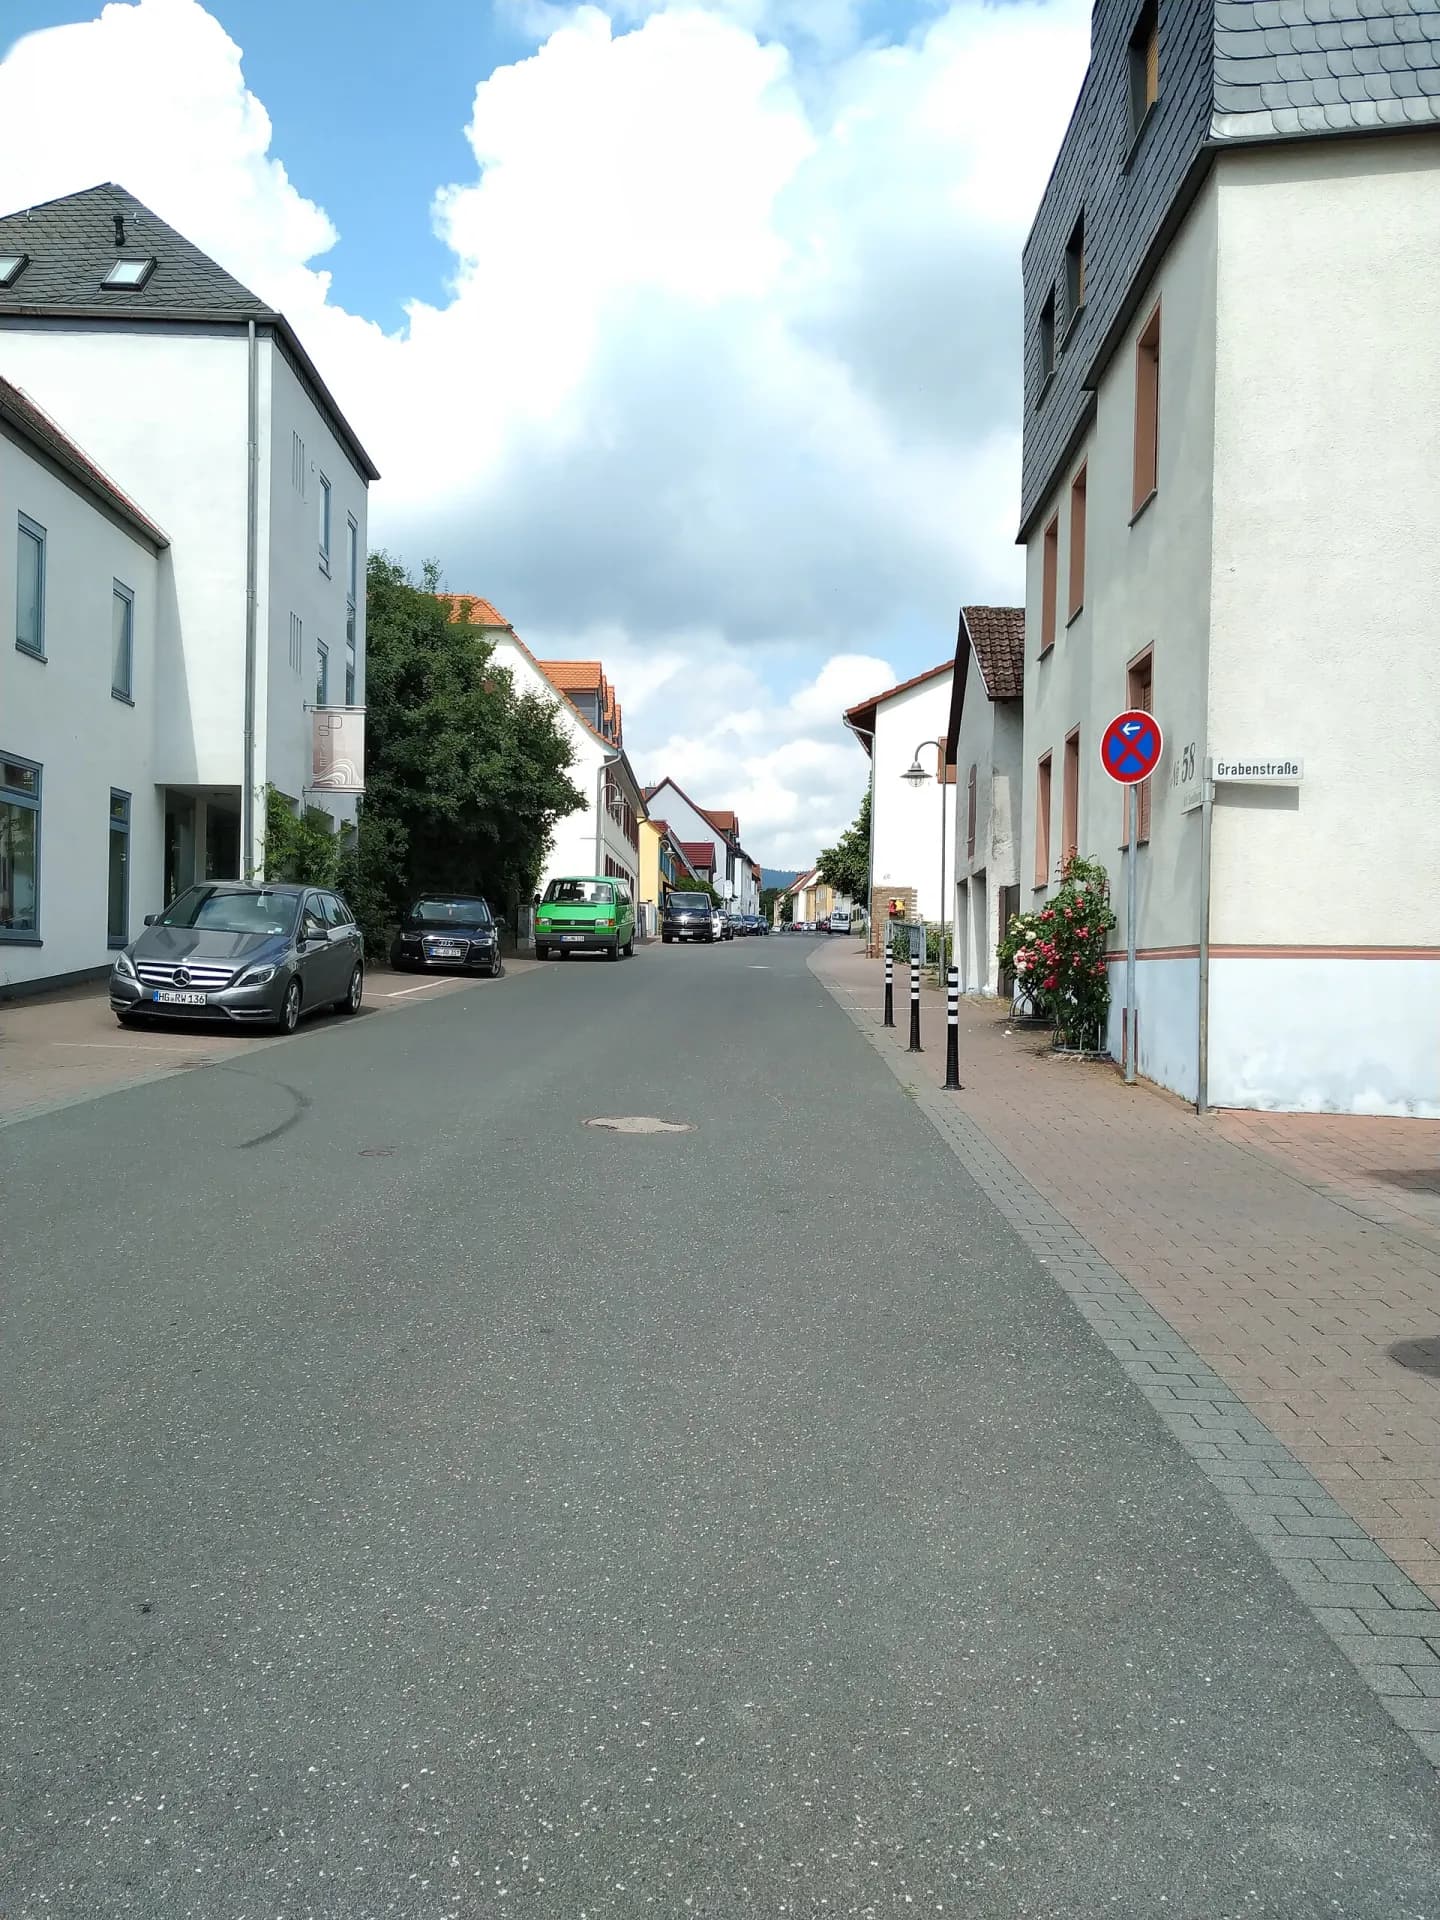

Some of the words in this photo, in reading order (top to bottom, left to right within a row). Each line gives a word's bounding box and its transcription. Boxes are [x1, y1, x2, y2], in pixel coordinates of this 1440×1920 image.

[1182, 742, 1196, 783] 58
[1217, 762, 1298, 776] Grabenstraße
[188, 994, 205, 1004] 136
